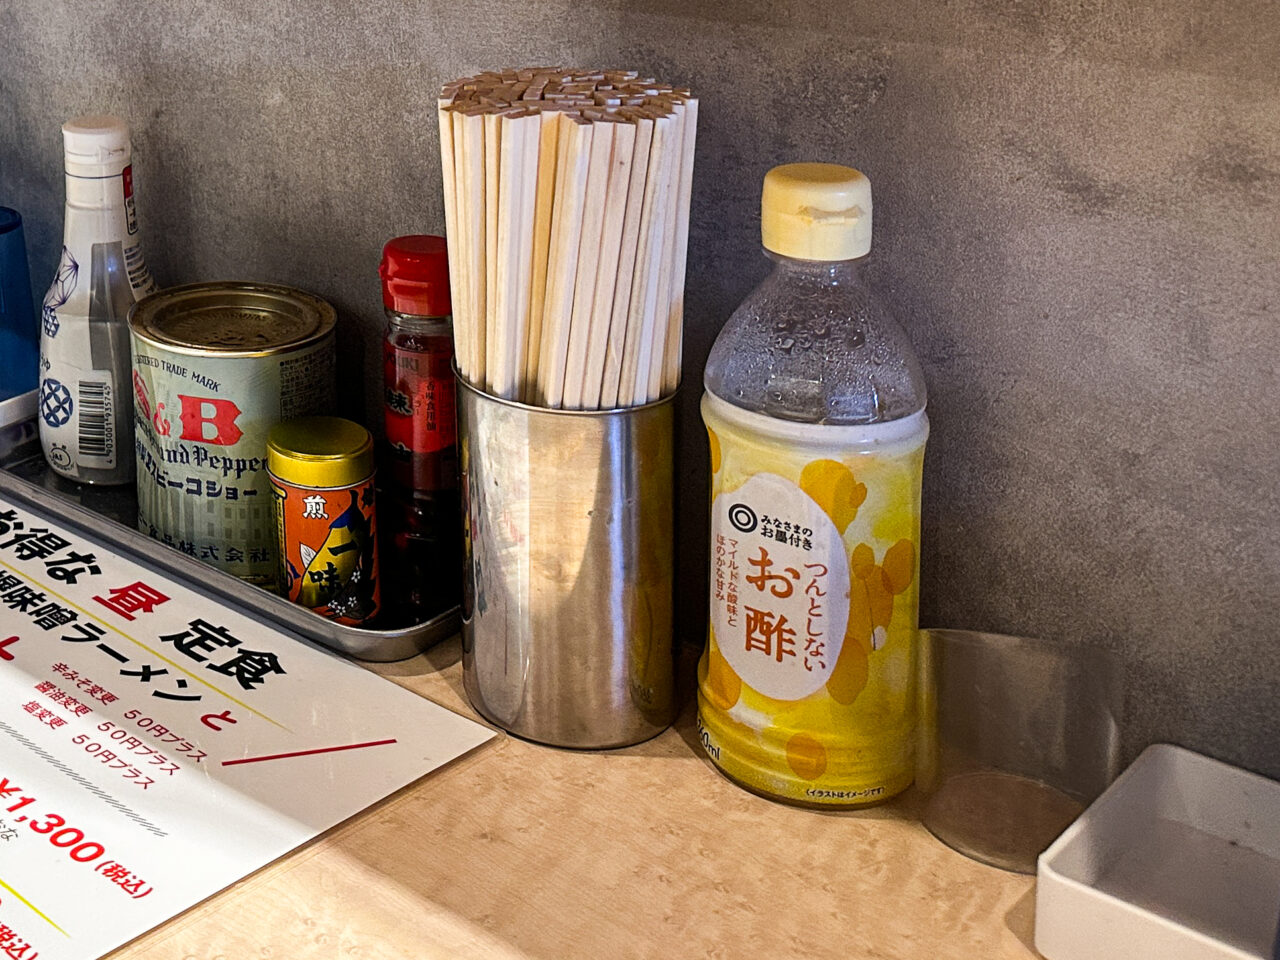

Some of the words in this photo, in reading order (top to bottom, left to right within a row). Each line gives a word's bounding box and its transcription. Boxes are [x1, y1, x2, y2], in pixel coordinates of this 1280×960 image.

[161, 360, 188, 378] TRADE
[191, 371, 222, 392] MARK
[177, 394, 244, 447] B
[761, 515, 813, 537] みなさまの
[744, 546, 800, 663] お酢
[804, 562, 828, 673] つんとしない
[92, 581, 171, 621] 昼
[159, 618, 287, 690] 定食
[34, 680, 95, 718] 醤油変更
[51, 661, 121, 705] 辛みそ変更
[22, 700, 68, 731] 塩変更
[200, 710, 238, 731] と
